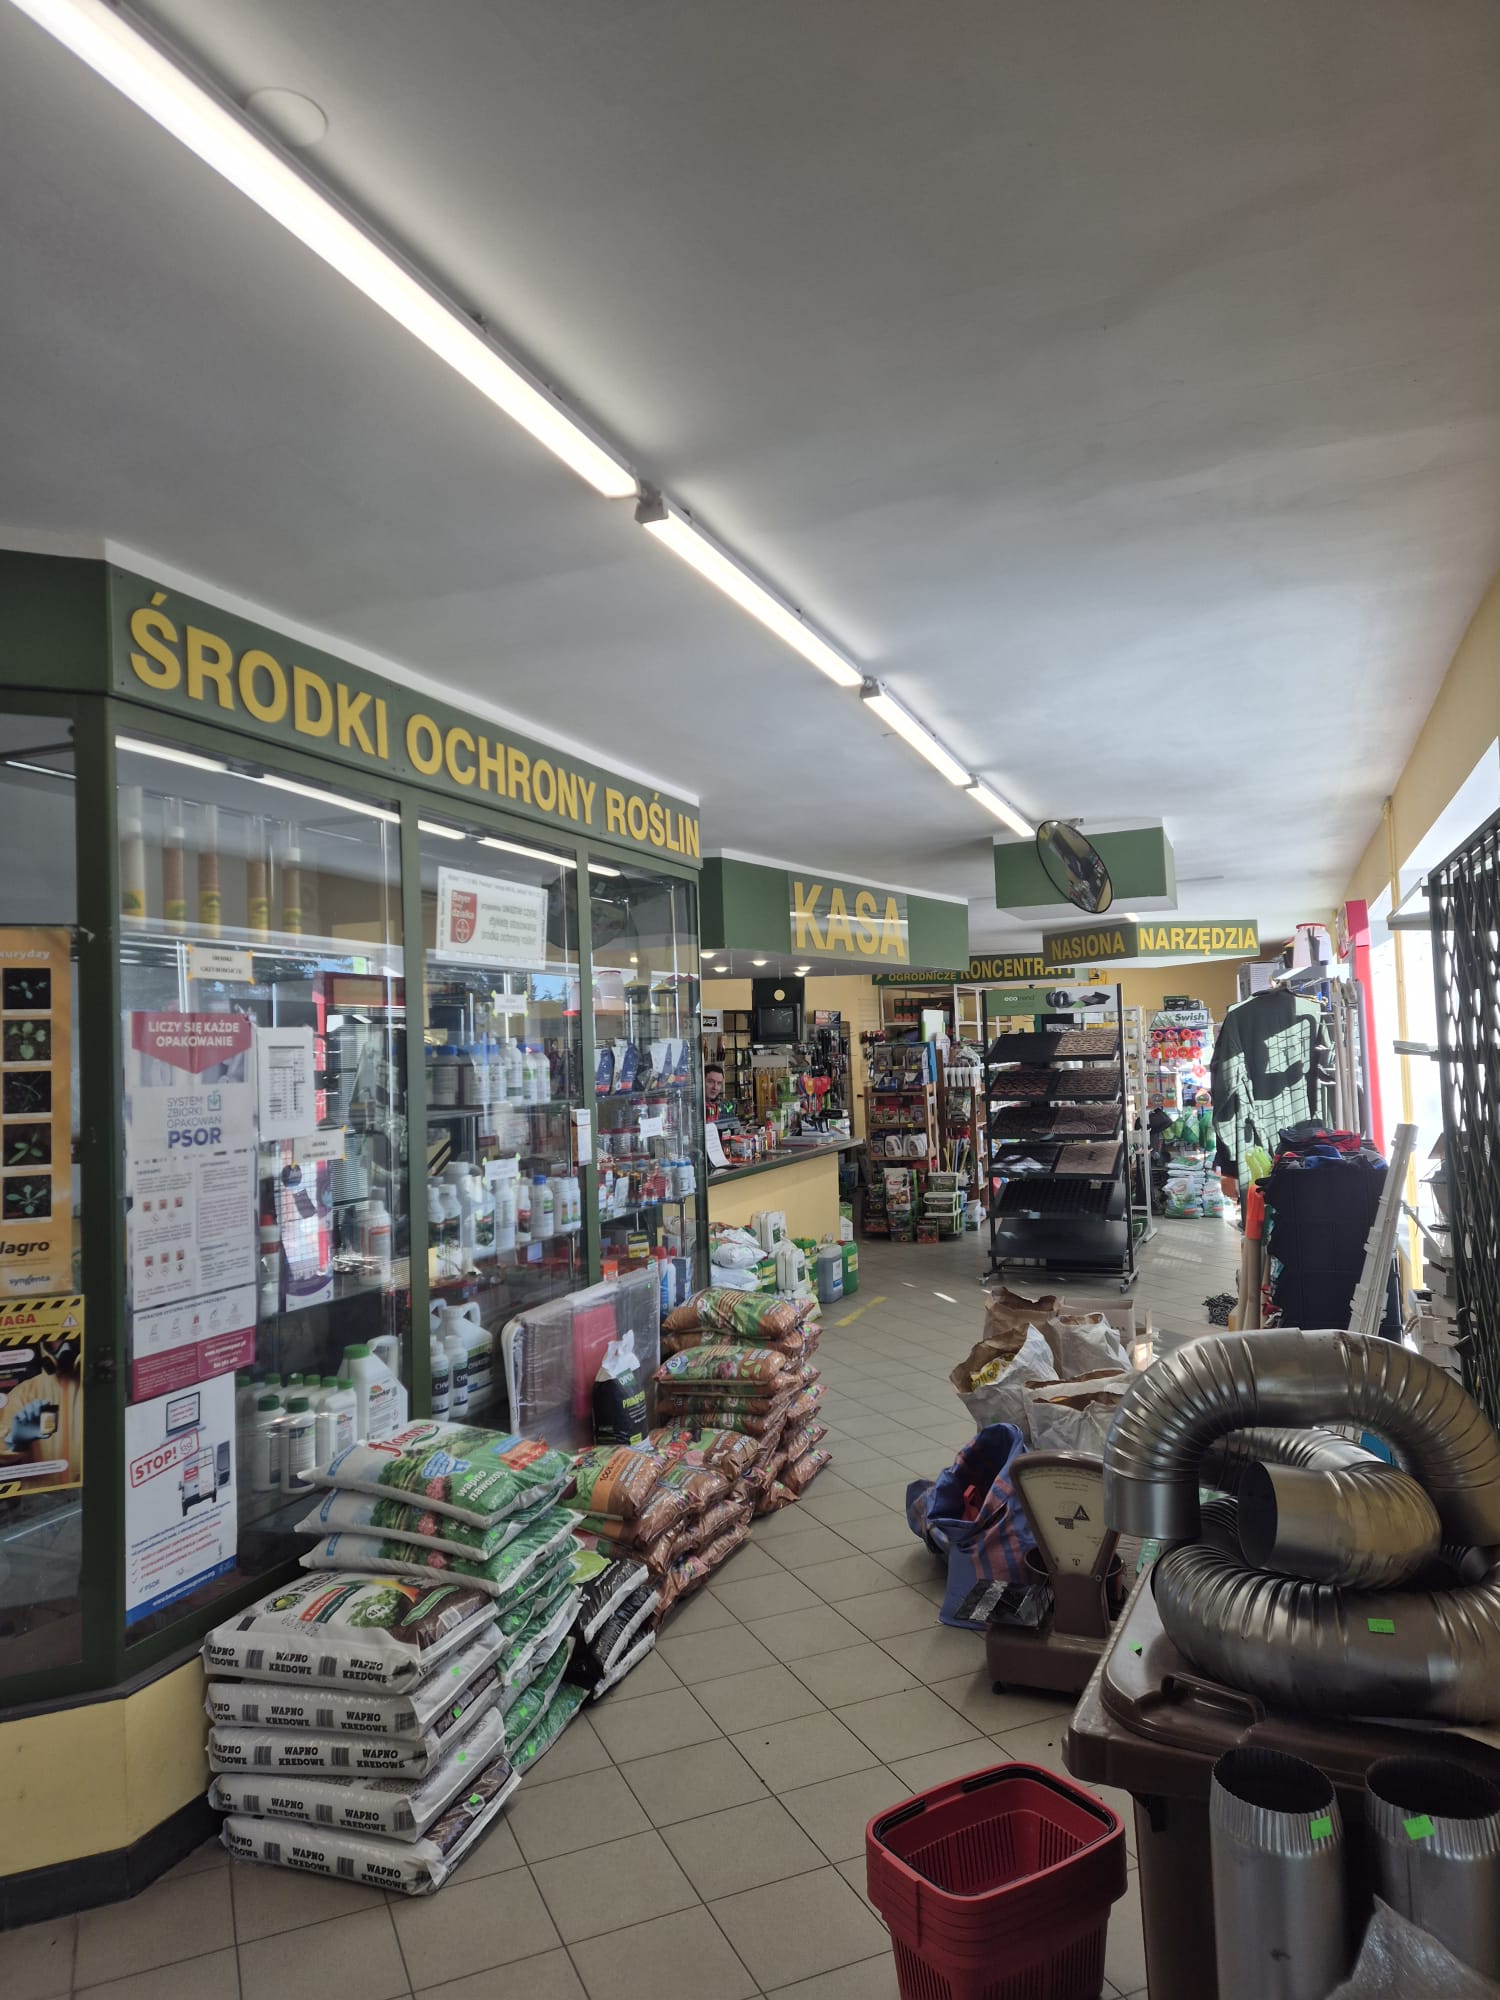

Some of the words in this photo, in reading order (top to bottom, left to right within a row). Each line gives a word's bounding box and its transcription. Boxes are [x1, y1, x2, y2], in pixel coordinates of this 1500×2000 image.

[130, 592, 389, 760] ŚRODKI
[406, 713, 597, 825] OCHRONY
[605, 792, 699, 858] ROŚLIN
[793, 881, 906, 958] KASA
[1051, 931, 1126, 961] NASIONA
[1138, 927, 1258, 956] NARZĘDZIA
[888, 971, 957, 982] OGRODNICZE
[1175, 1012, 1205, 1021] Swish
[148, 1021, 180, 1033] LICZY
[184, 1021, 202, 1035] SIĘ
[203, 1019, 240, 1033] KAŻDE
[155, 1035, 233, 1047] OPAKOWANIE
[168, 1127, 222, 1149] PSOR
[9, 1274, 51, 1286] syngenta
[135, 1446, 177, 1480] STOP!
[457, 1470, 487, 1497] wapno
[275, 1651, 308, 1663] WAPNO
[269, 1663, 312, 1675] KREDOWE
[350, 1658, 383, 1671] WAPNO
[342, 1670, 388, 1684] KREDOWE
[271, 1706, 304, 1716] WAPNO
[346, 1711, 381, 1722] WAPNO
[265, 1717, 311, 1727] KREDOWE
[340, 1721, 388, 1733] KREDOWE
[284, 1746, 319, 1756] WAPNO
[362, 1748, 399, 1759] WAPNO
[278, 1757, 325, 1766] KREDOWE
[356, 1760, 405, 1769] KREDOWE
[271, 1798, 304, 1810] WAPNO
[345, 1808, 380, 1821] WAPNO
[339, 1819, 387, 1832] KREDOWE
[292, 1847, 325, 1862] WAPNO
[287, 1858, 331, 1873] KREDOWE
[366, 1863, 401, 1878] WAPNO
[361, 1873, 408, 1891] KREDOWE
